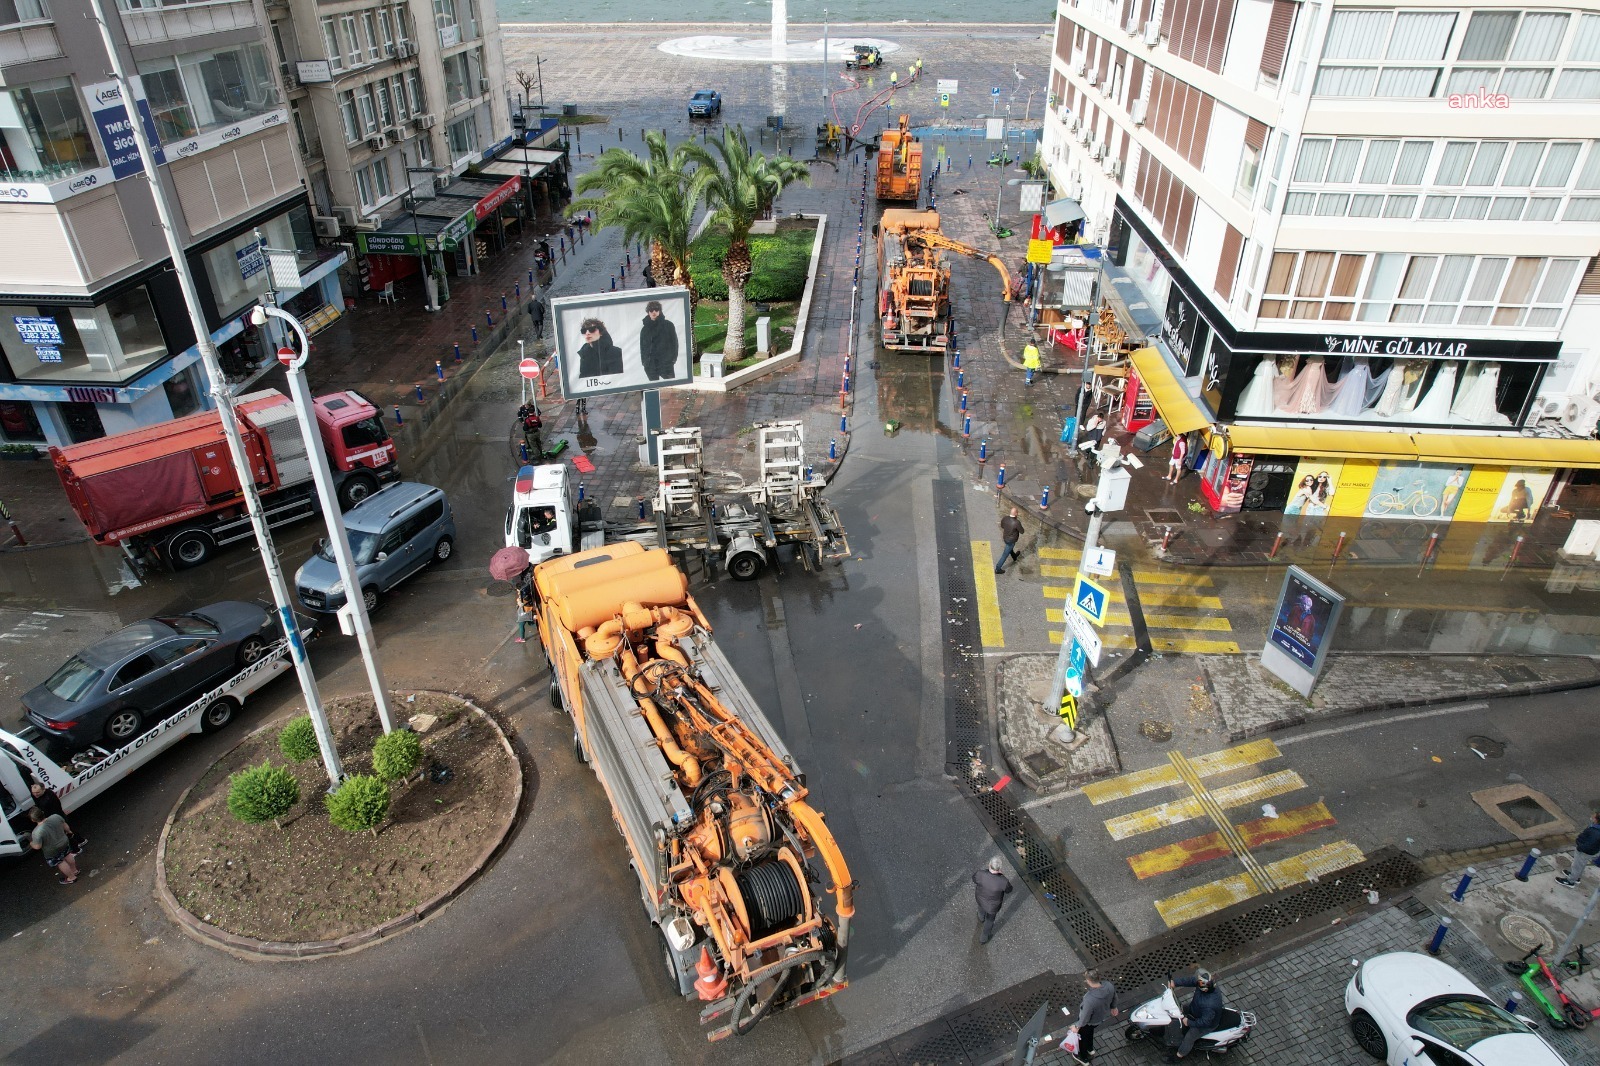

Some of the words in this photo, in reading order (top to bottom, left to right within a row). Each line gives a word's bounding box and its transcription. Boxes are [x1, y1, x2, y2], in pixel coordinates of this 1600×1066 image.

[105, 121, 124, 135] TMR
[19, 324, 58, 332] SATILIK
[1341, 336, 1382, 354] MİNE
[1386, 337, 1468, 357] GÜLAYLAR
[586, 378, 599, 388] LTB
[374, 450, 385, 460] 112
[78, 746, 131, 786] FURKAN
[135, 729, 160, 749] OTO
[164, 687, 225, 732] KURTARMA
[229, 668, 252, 688] 0507
[253, 657, 269, 673] 477
